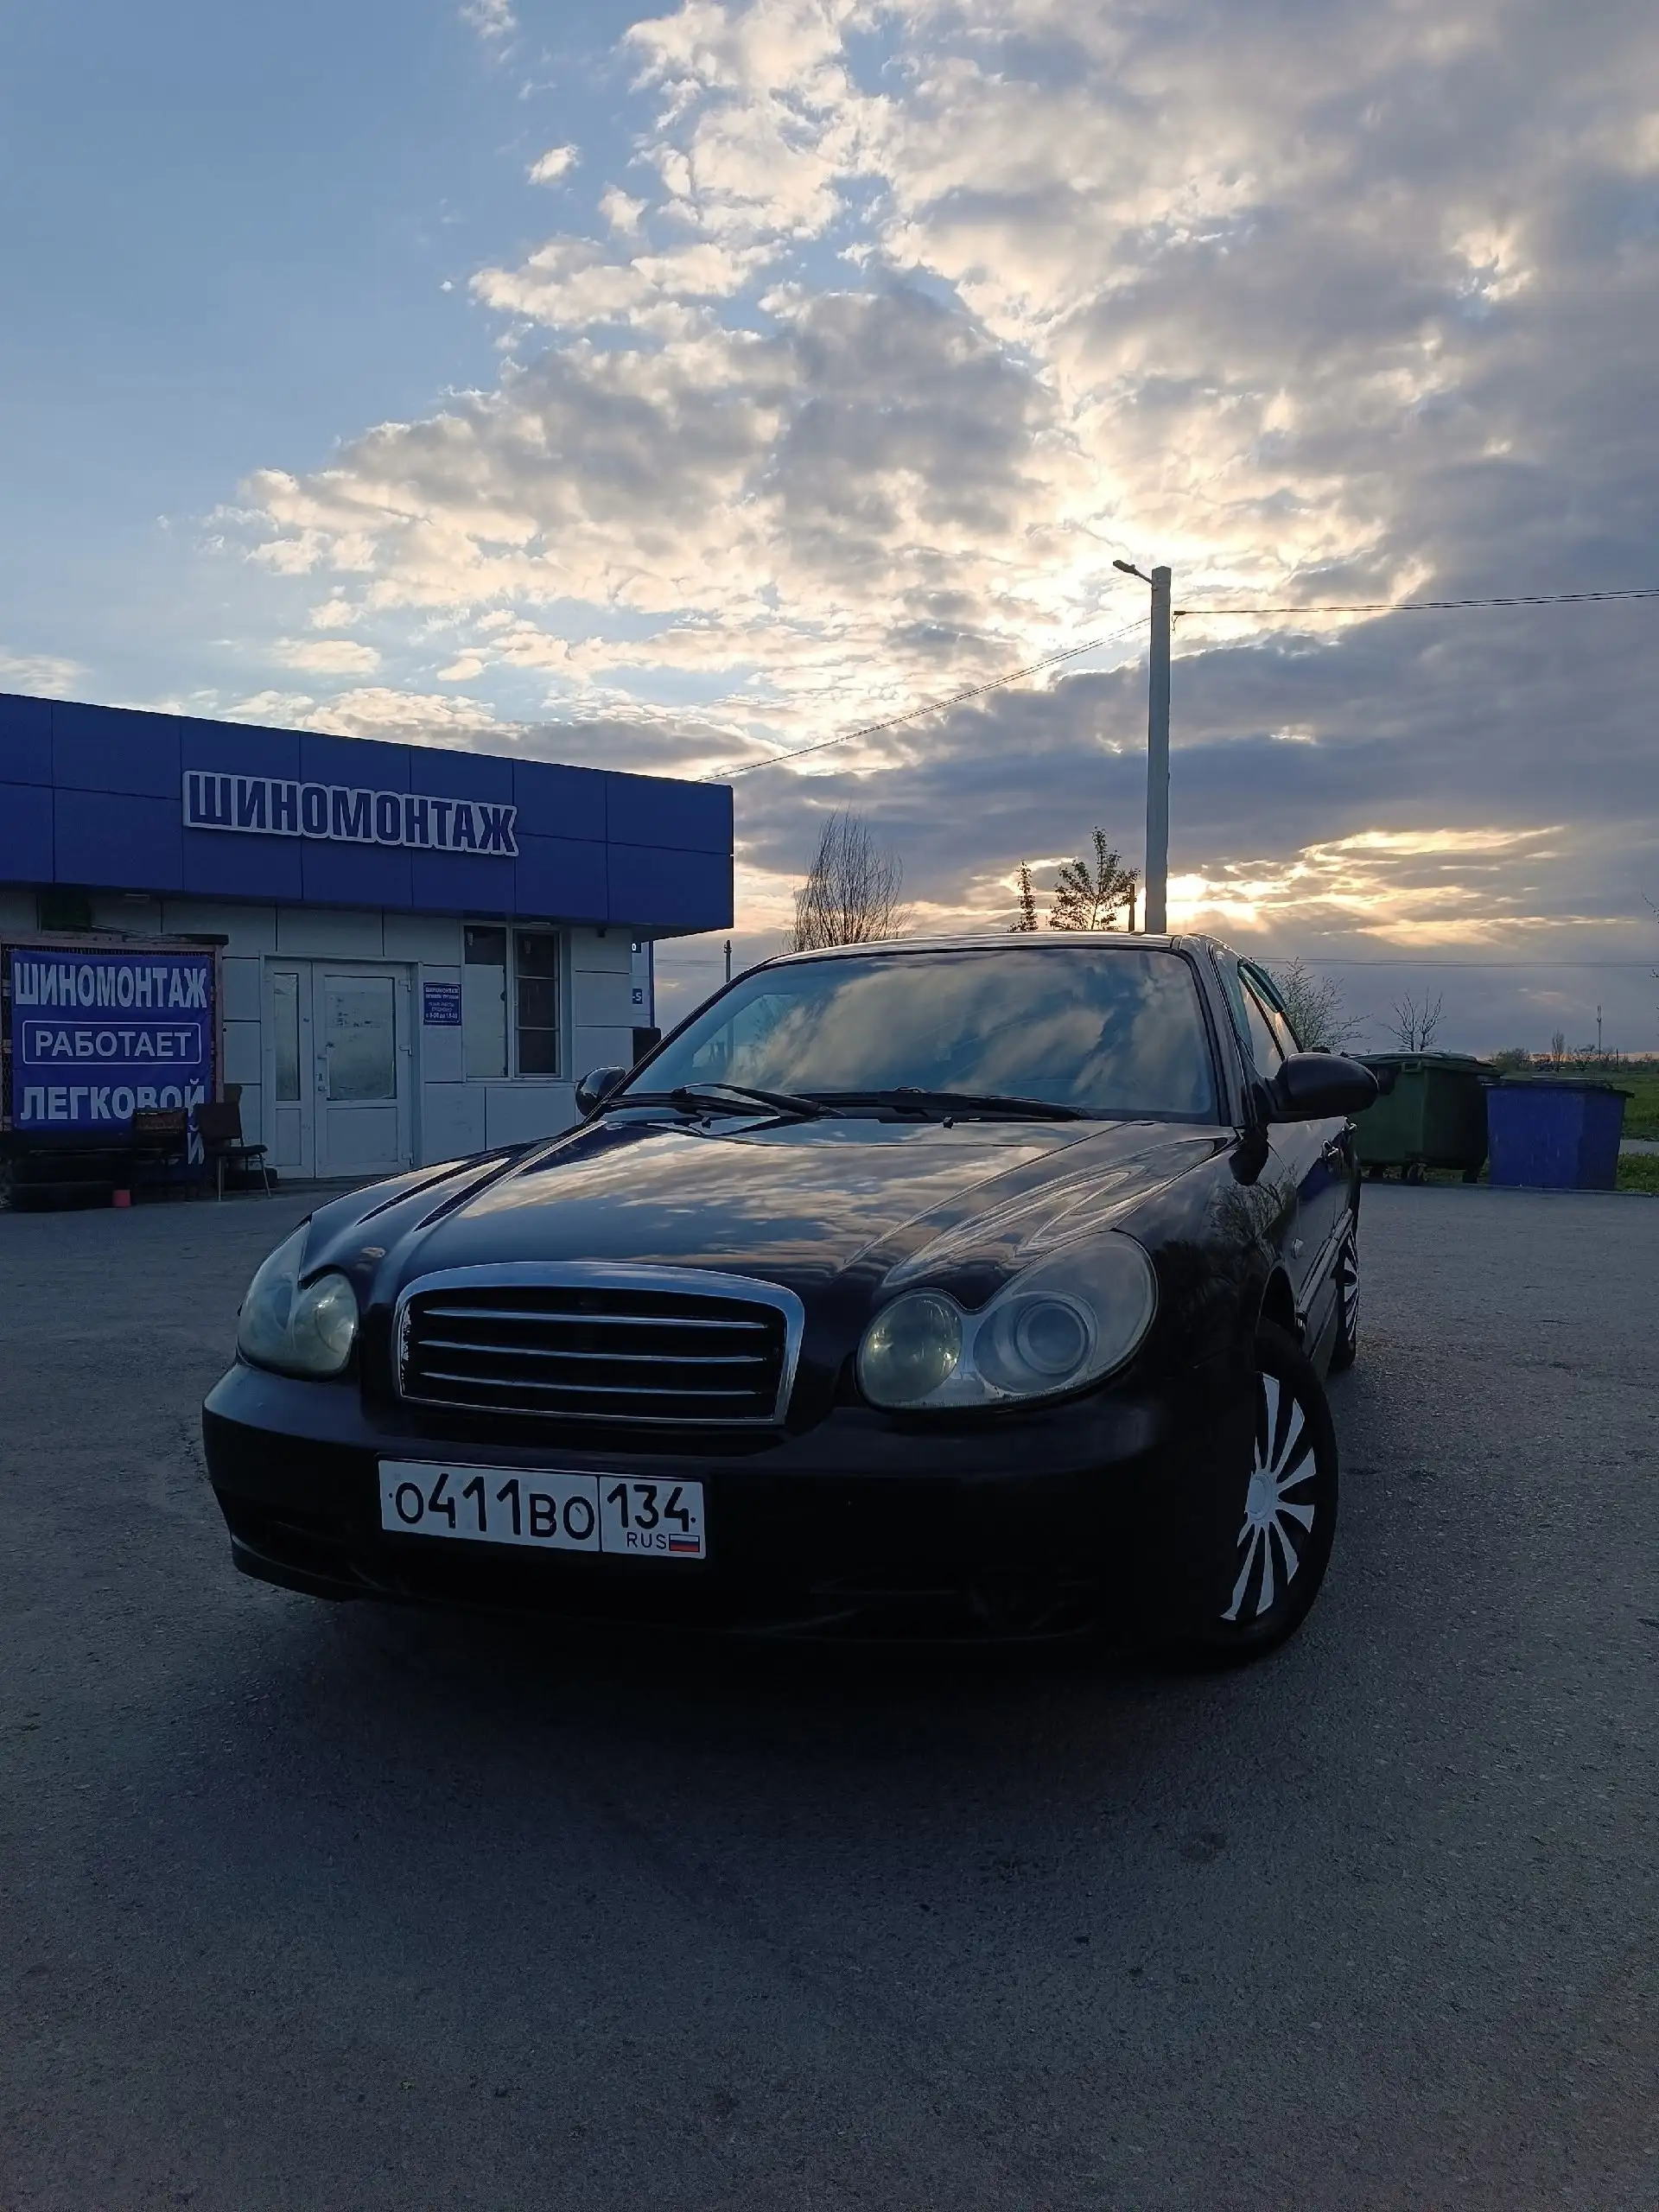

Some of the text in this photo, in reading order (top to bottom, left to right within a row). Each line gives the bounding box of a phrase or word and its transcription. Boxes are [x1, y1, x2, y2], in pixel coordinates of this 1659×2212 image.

[185, 772, 518, 855] ШИНОМОНТАЖ
[14, 962, 208, 1009] ШИНОМОНТАЖ
[35, 1030, 192, 1058] РАБОТАЕТ
[20, 1077, 206, 1121] ЛЕГКОВОЙ
[607, 1483, 690, 1533] 134
[626, 1532, 667, 1550] RUS
